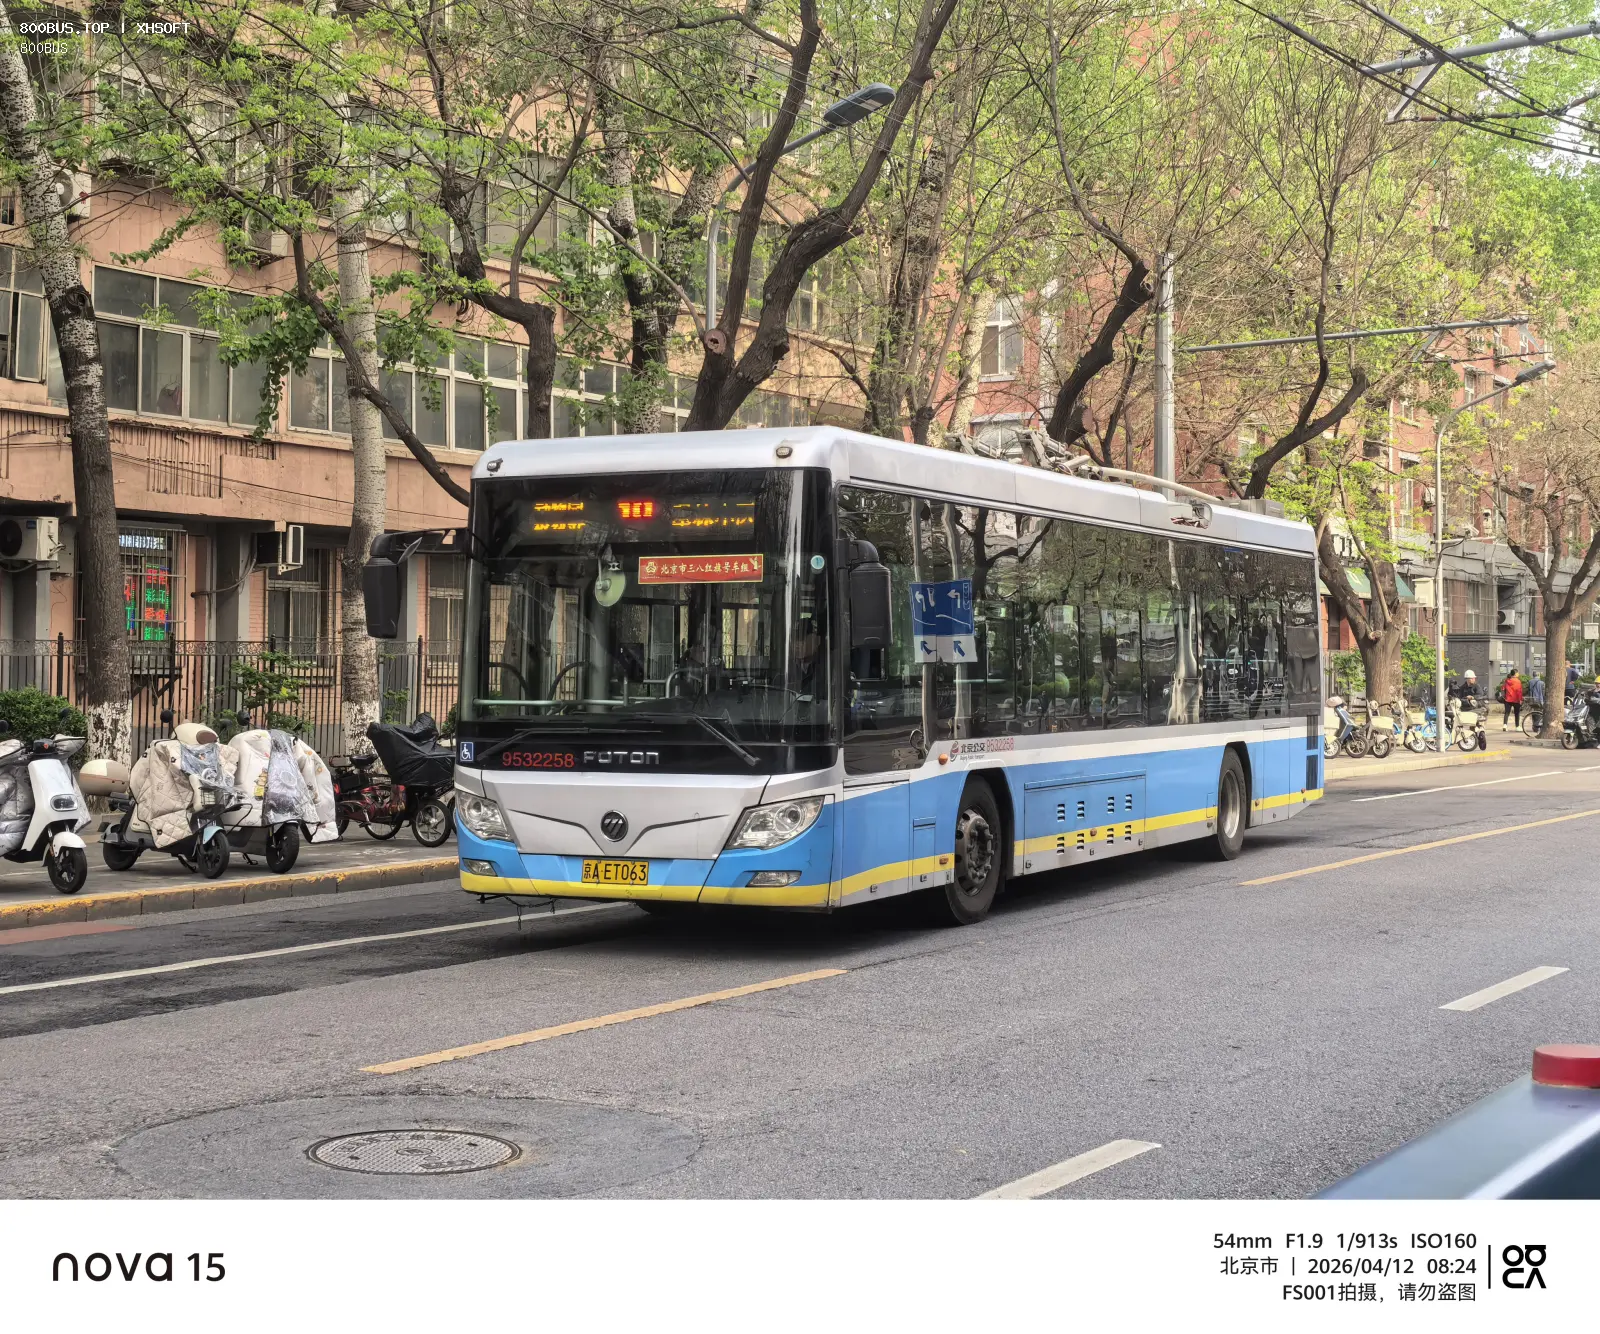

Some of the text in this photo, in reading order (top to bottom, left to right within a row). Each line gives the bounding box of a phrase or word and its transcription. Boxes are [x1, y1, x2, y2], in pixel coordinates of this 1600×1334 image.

[660, 561, 749, 575] 北京市三八红旗号车组
[960, 742, 986, 753] 北京公交
[502, 751, 575, 768] 9532258
